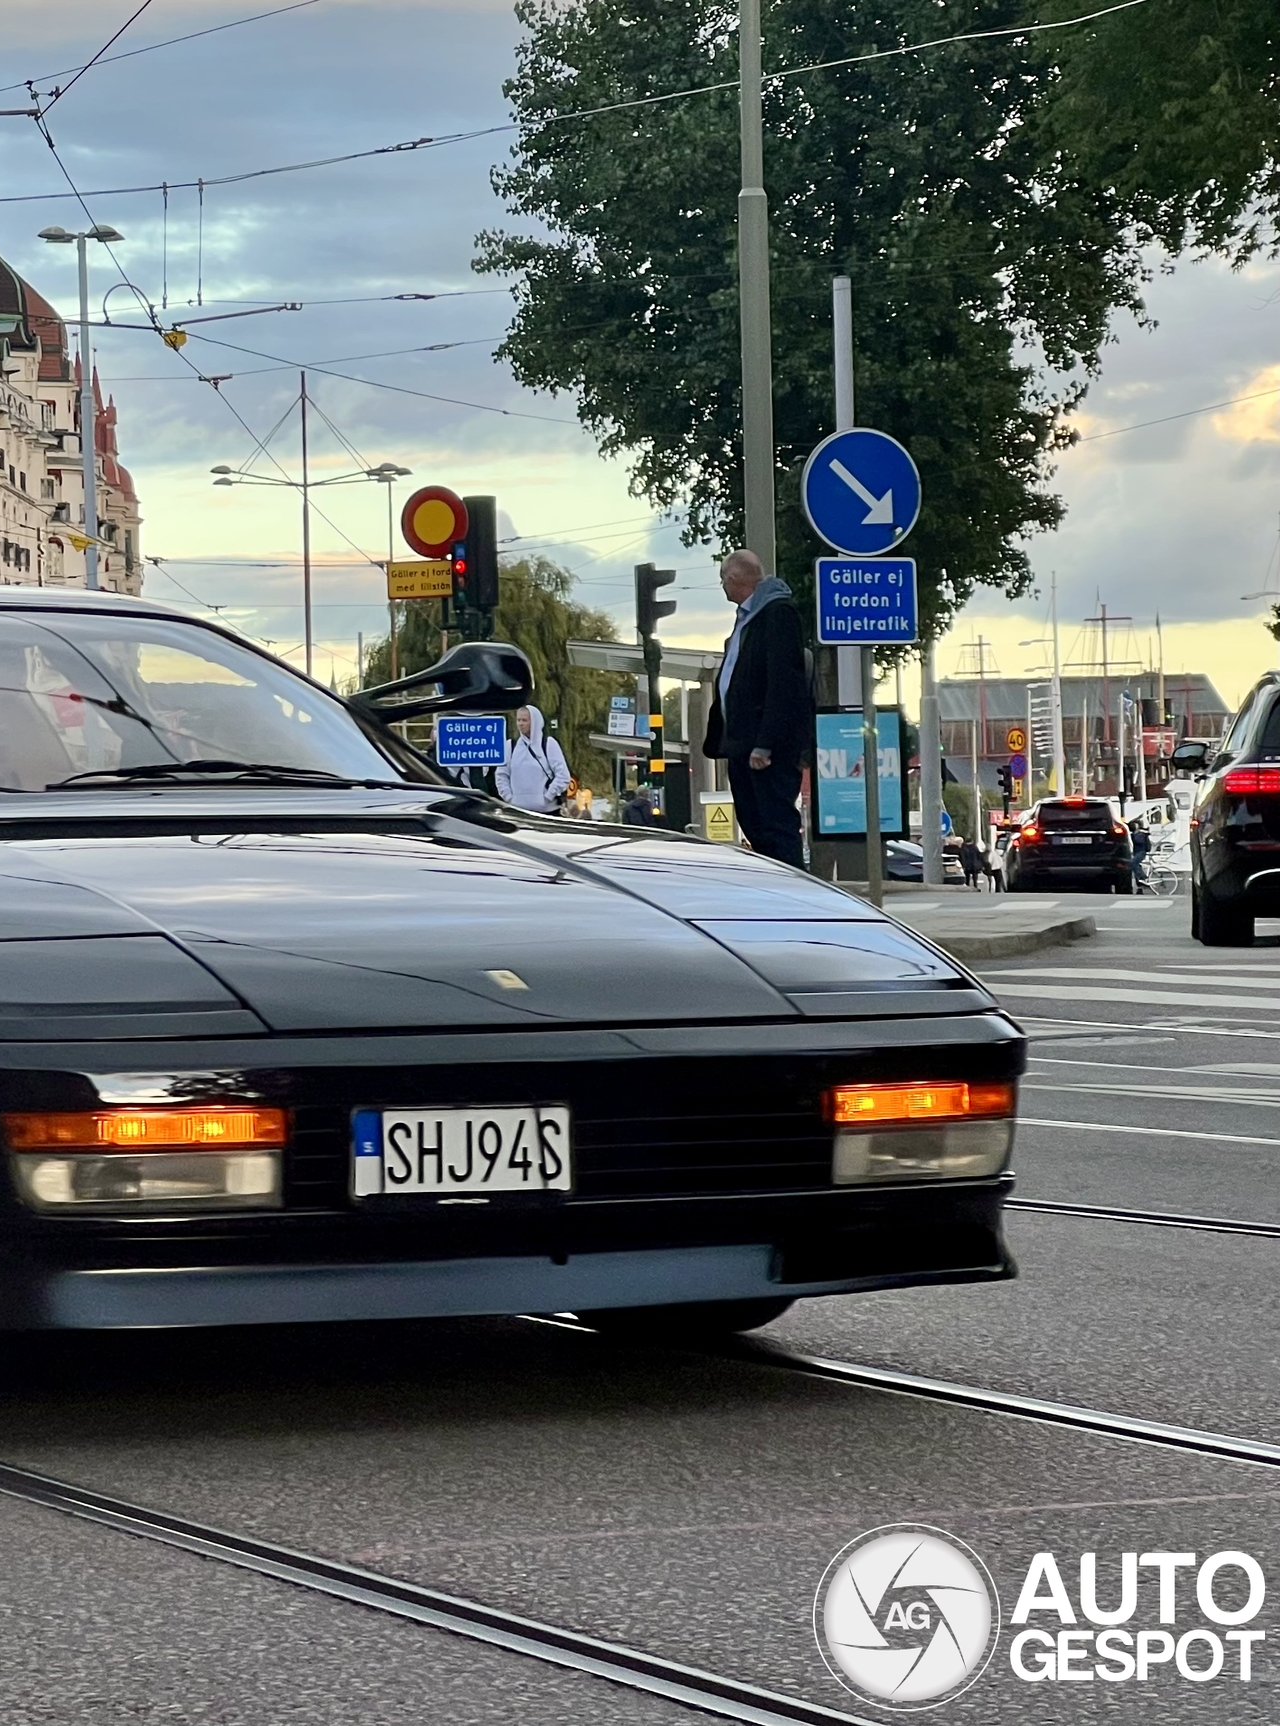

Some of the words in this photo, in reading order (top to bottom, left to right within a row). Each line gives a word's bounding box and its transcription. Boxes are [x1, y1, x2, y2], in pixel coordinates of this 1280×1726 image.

[391, 569, 418, 578] Gäller
[421, 568, 429, 578] ej
[432, 568, 451, 576] ford
[830, 569, 881, 584] Gäller
[888, 569, 903, 587] ej
[396, 583, 415, 592] med
[420, 582, 451, 591] tillstån
[834, 592, 889, 607] fordon
[896, 592, 901, 607] i
[825, 616, 909, 634] linjetrafik
[446, 723, 482, 732] Gäller
[486, 722, 497, 733] ej
[448, 737, 487, 746] fordon
[491, 735, 495, 745] i
[1009, 734, 1024, 747] 40
[442, 749, 500, 761] linjetrafik
[387, 1119, 562, 1185] SHJ94S
